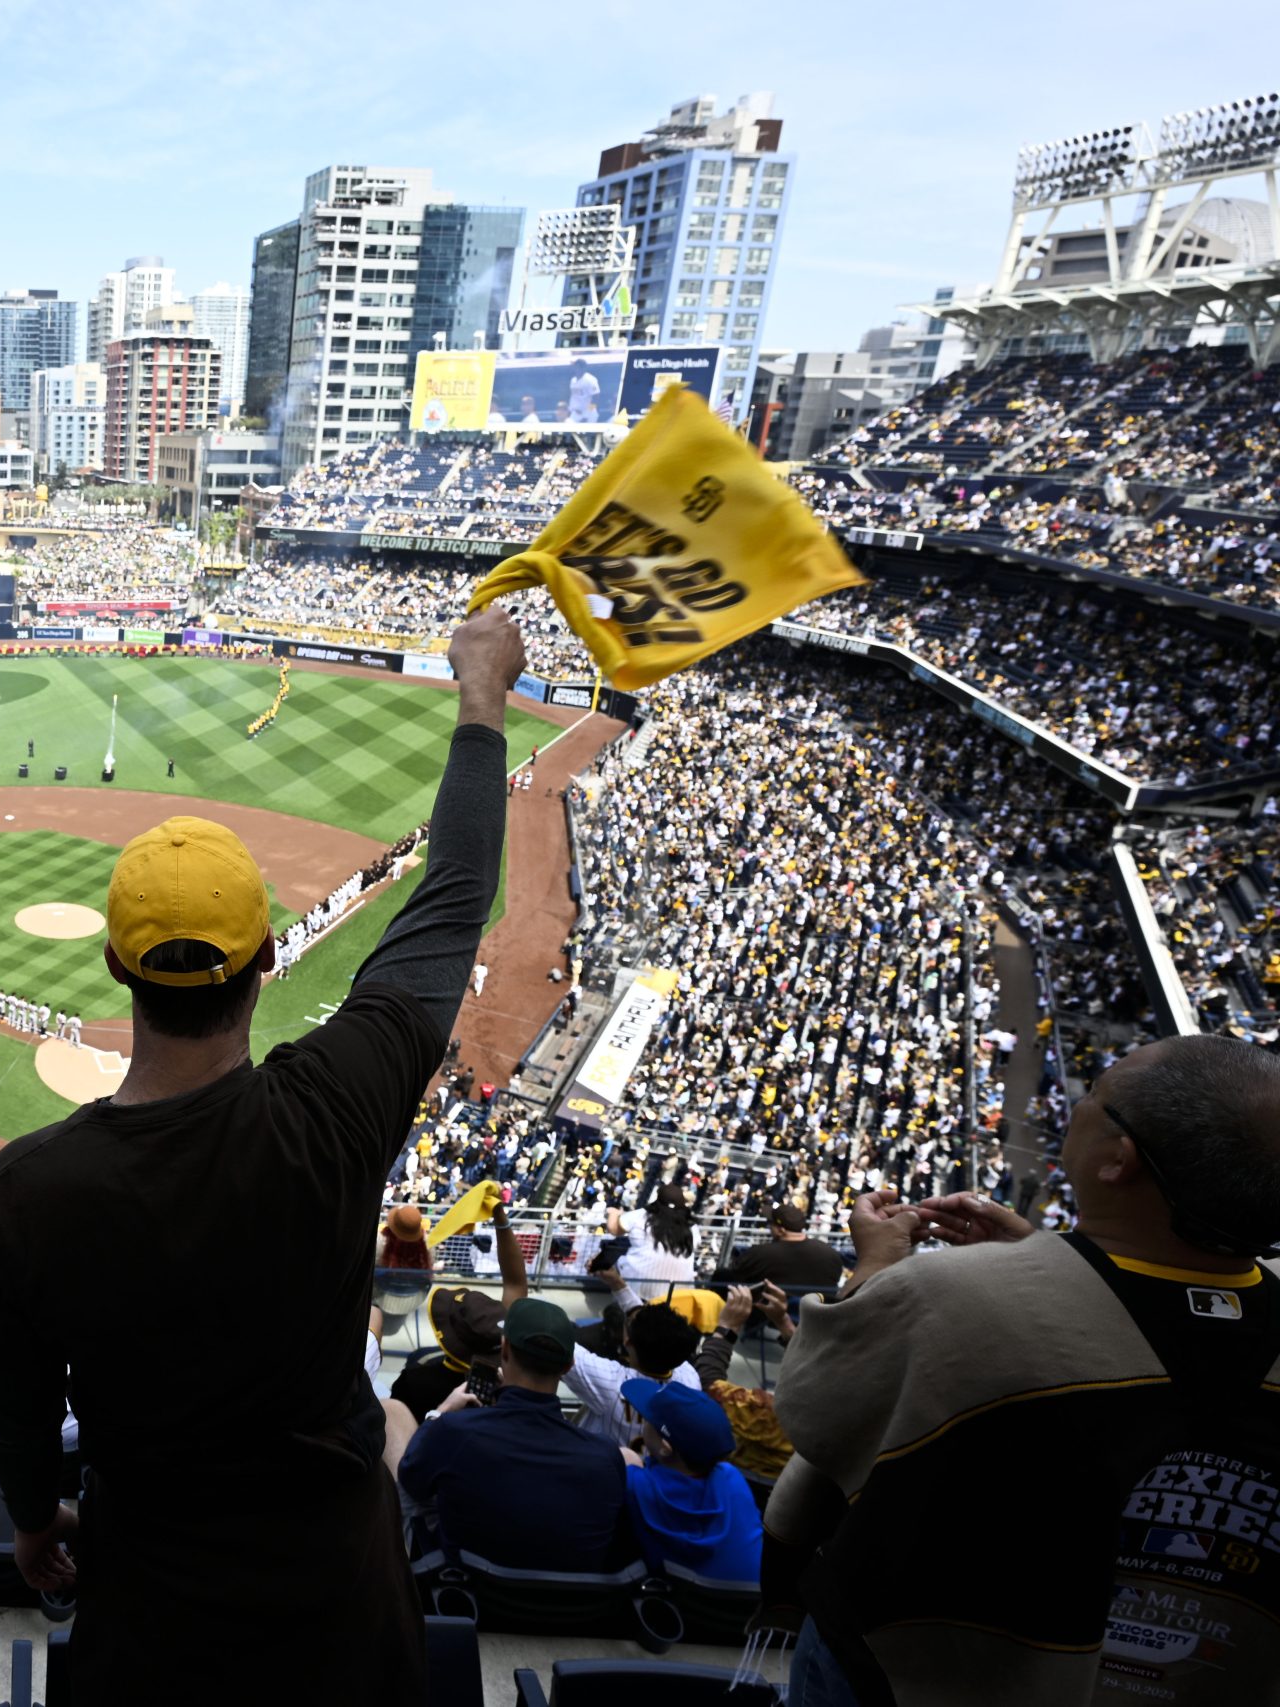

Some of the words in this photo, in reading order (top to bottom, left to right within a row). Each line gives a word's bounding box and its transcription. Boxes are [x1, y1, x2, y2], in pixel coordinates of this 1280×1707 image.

[505, 310, 589, 332] Viasat
[570, 501, 688, 558] ET'S
[360, 535, 412, 549] WELCOME
[414, 537, 429, 550] TO
[431, 538, 469, 553] PETCO
[470, 541, 503, 556] PARK
[587, 1055, 617, 1085] FOR
[608, 997, 656, 1051] FAITHFUL
[1161, 1450, 1273, 1481] MONTERREY
[1131, 1464, 1280, 1514] EXIC
[1115, 1555, 1149, 1572] MAY
[1146, 1590, 1201, 1614] MLB
[1109, 1600, 1158, 1620] RLD
[1164, 1611, 1232, 1640] TOUR
[1108, 1631, 1166, 1650] SERIES
[1155, 1631, 1192, 1646] CITY
